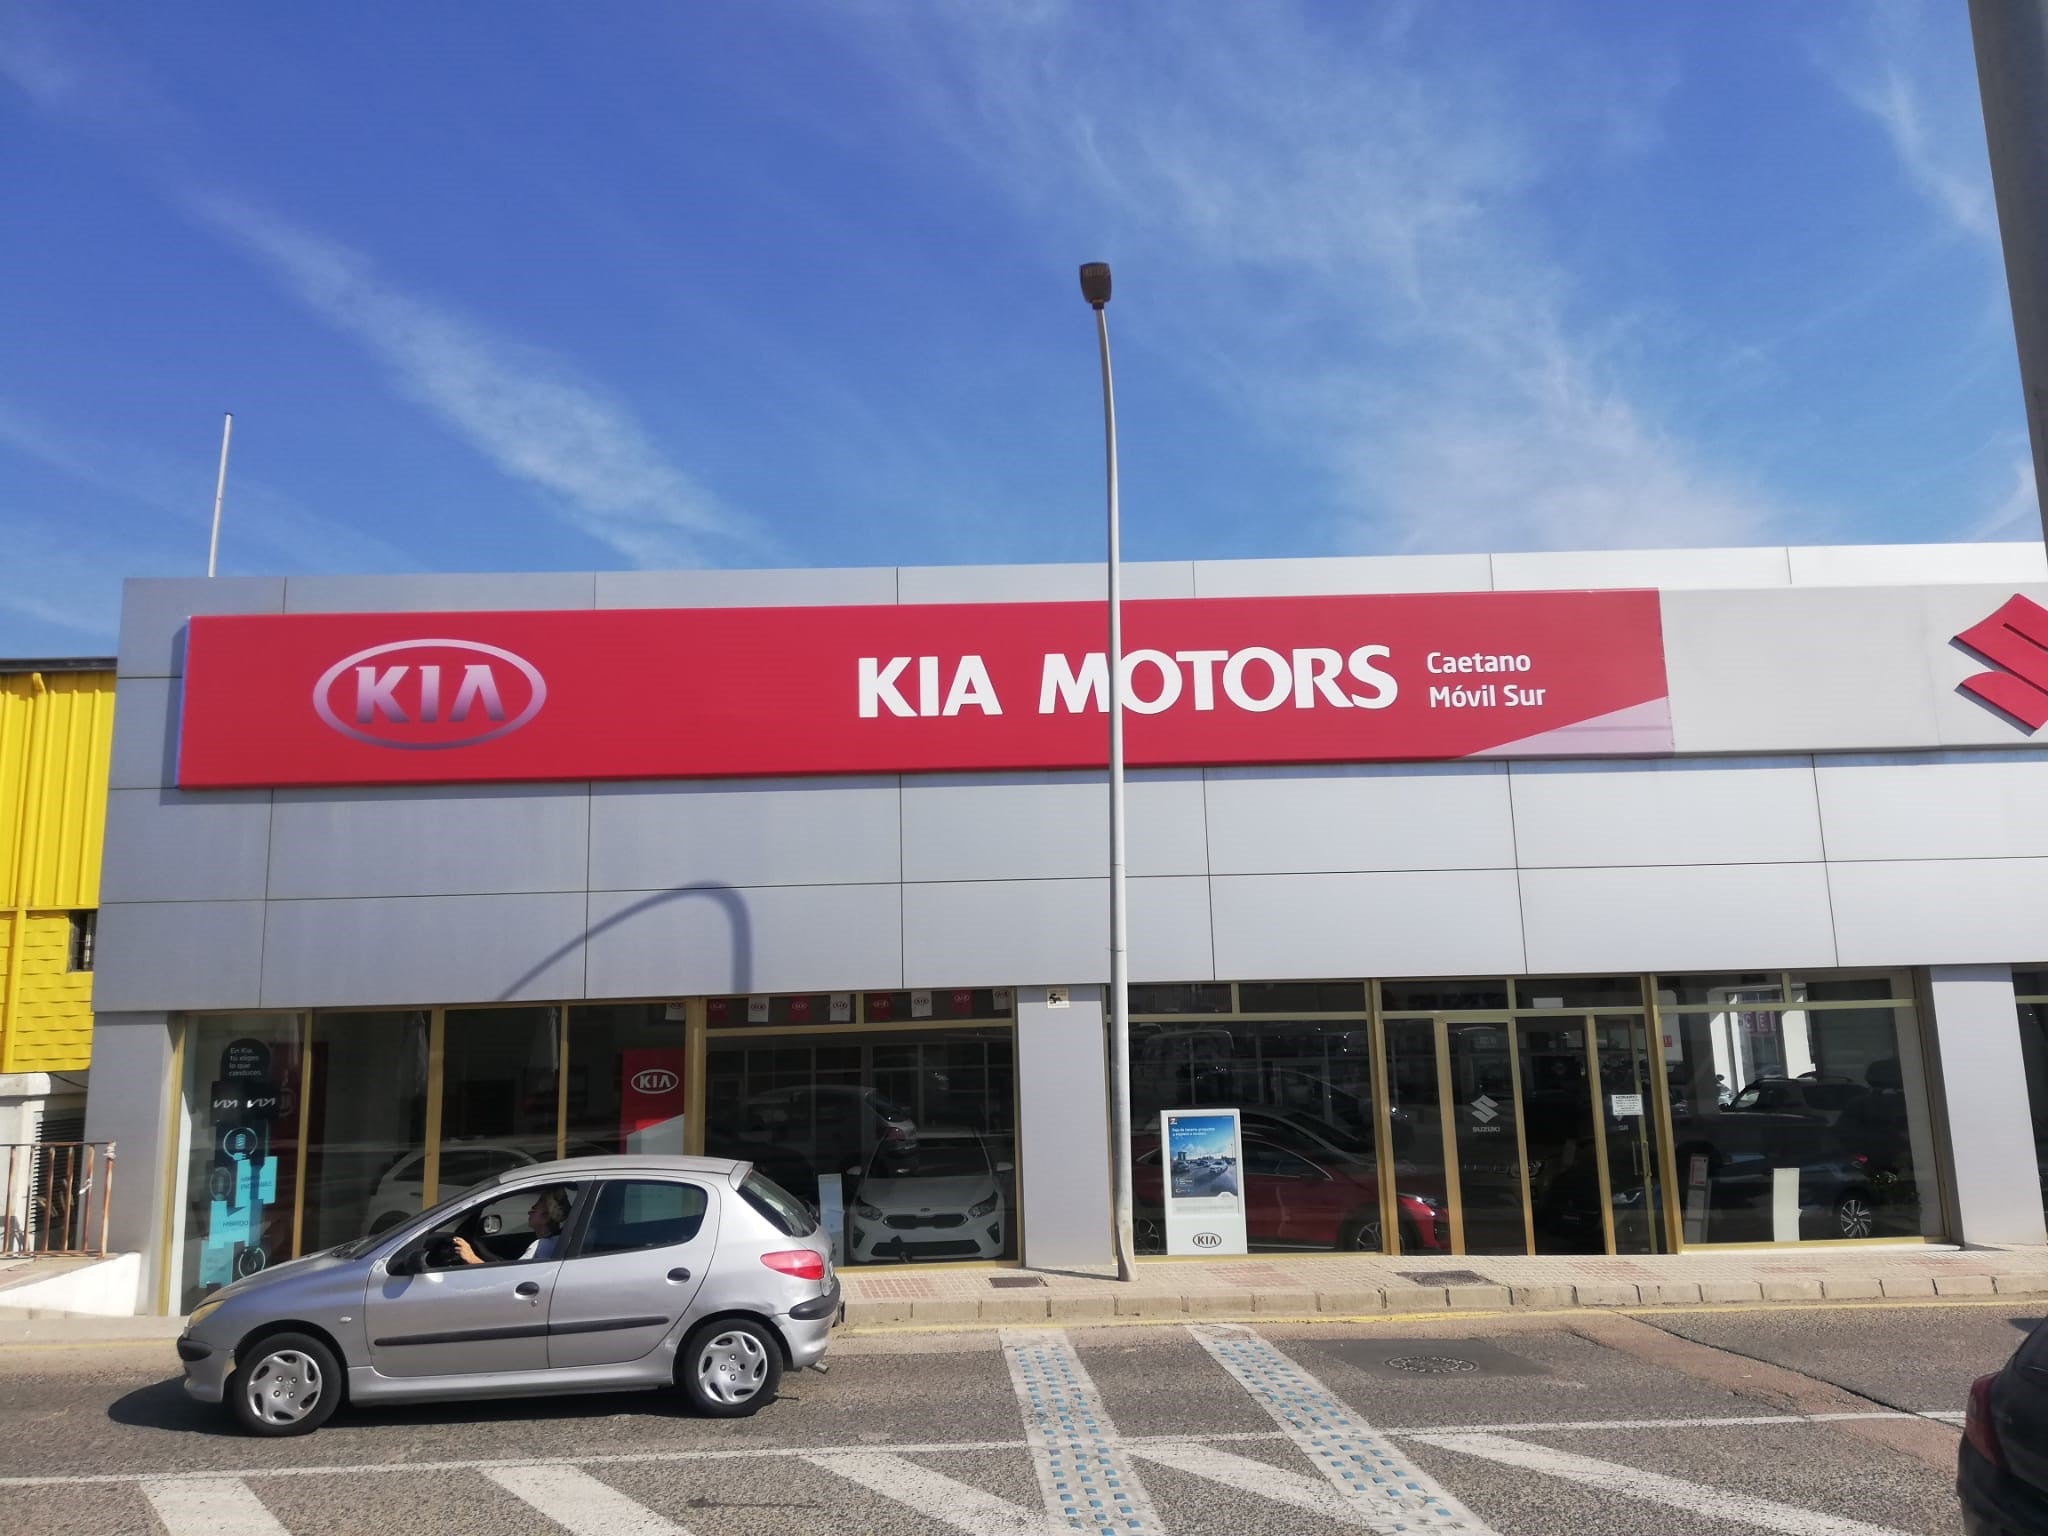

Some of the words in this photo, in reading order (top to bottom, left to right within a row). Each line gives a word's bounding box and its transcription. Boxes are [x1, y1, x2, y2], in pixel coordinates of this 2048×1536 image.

[1427, 651, 1531, 673] Caetano
[858, 655, 1003, 718] KIA
[1038, 644, 1398, 715] MOTORS
[355, 664, 505, 724] KIA
[1429, 684, 1496, 708] Móvil
[1503, 684, 1546, 707] Sur
[639, 1075, 671, 1089] KIA
[1197, 1235, 1217, 1245] KIA
